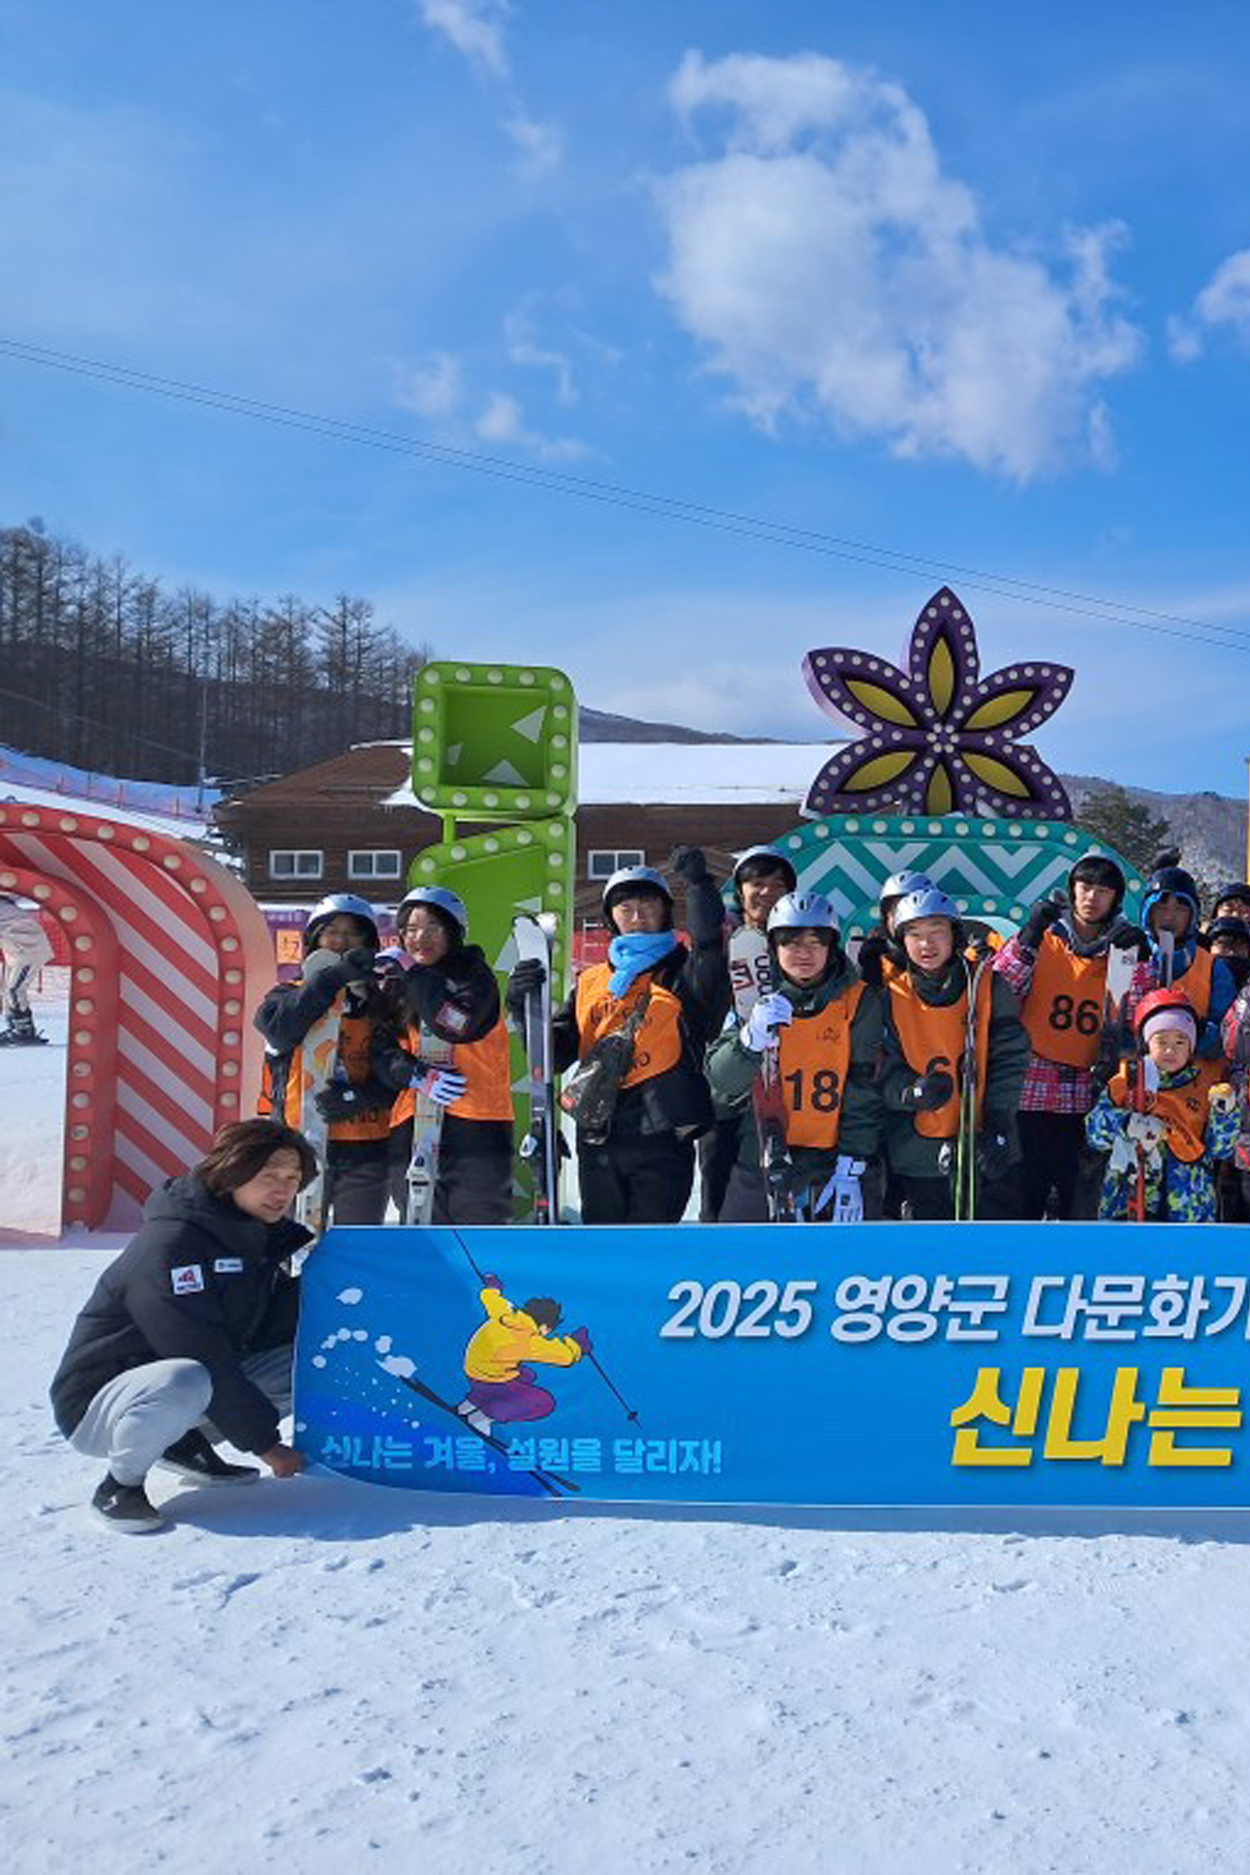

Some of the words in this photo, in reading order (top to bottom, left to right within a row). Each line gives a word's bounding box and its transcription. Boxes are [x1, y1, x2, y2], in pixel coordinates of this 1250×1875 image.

[1048, 994, 1099, 1035] 86
[785, 1069, 840, 1112] 18
[660, 1281, 817, 1338] 2025
[830, 1275, 1010, 1342] 영양군
[950, 1367, 1243, 1467] 신나는
[320, 1436, 413, 1468] 신나는
[424, 1436, 497, 1474] 겨울,
[507, 1437, 601, 1473] 설원을
[613, 1439, 722, 1474] 달리자!
